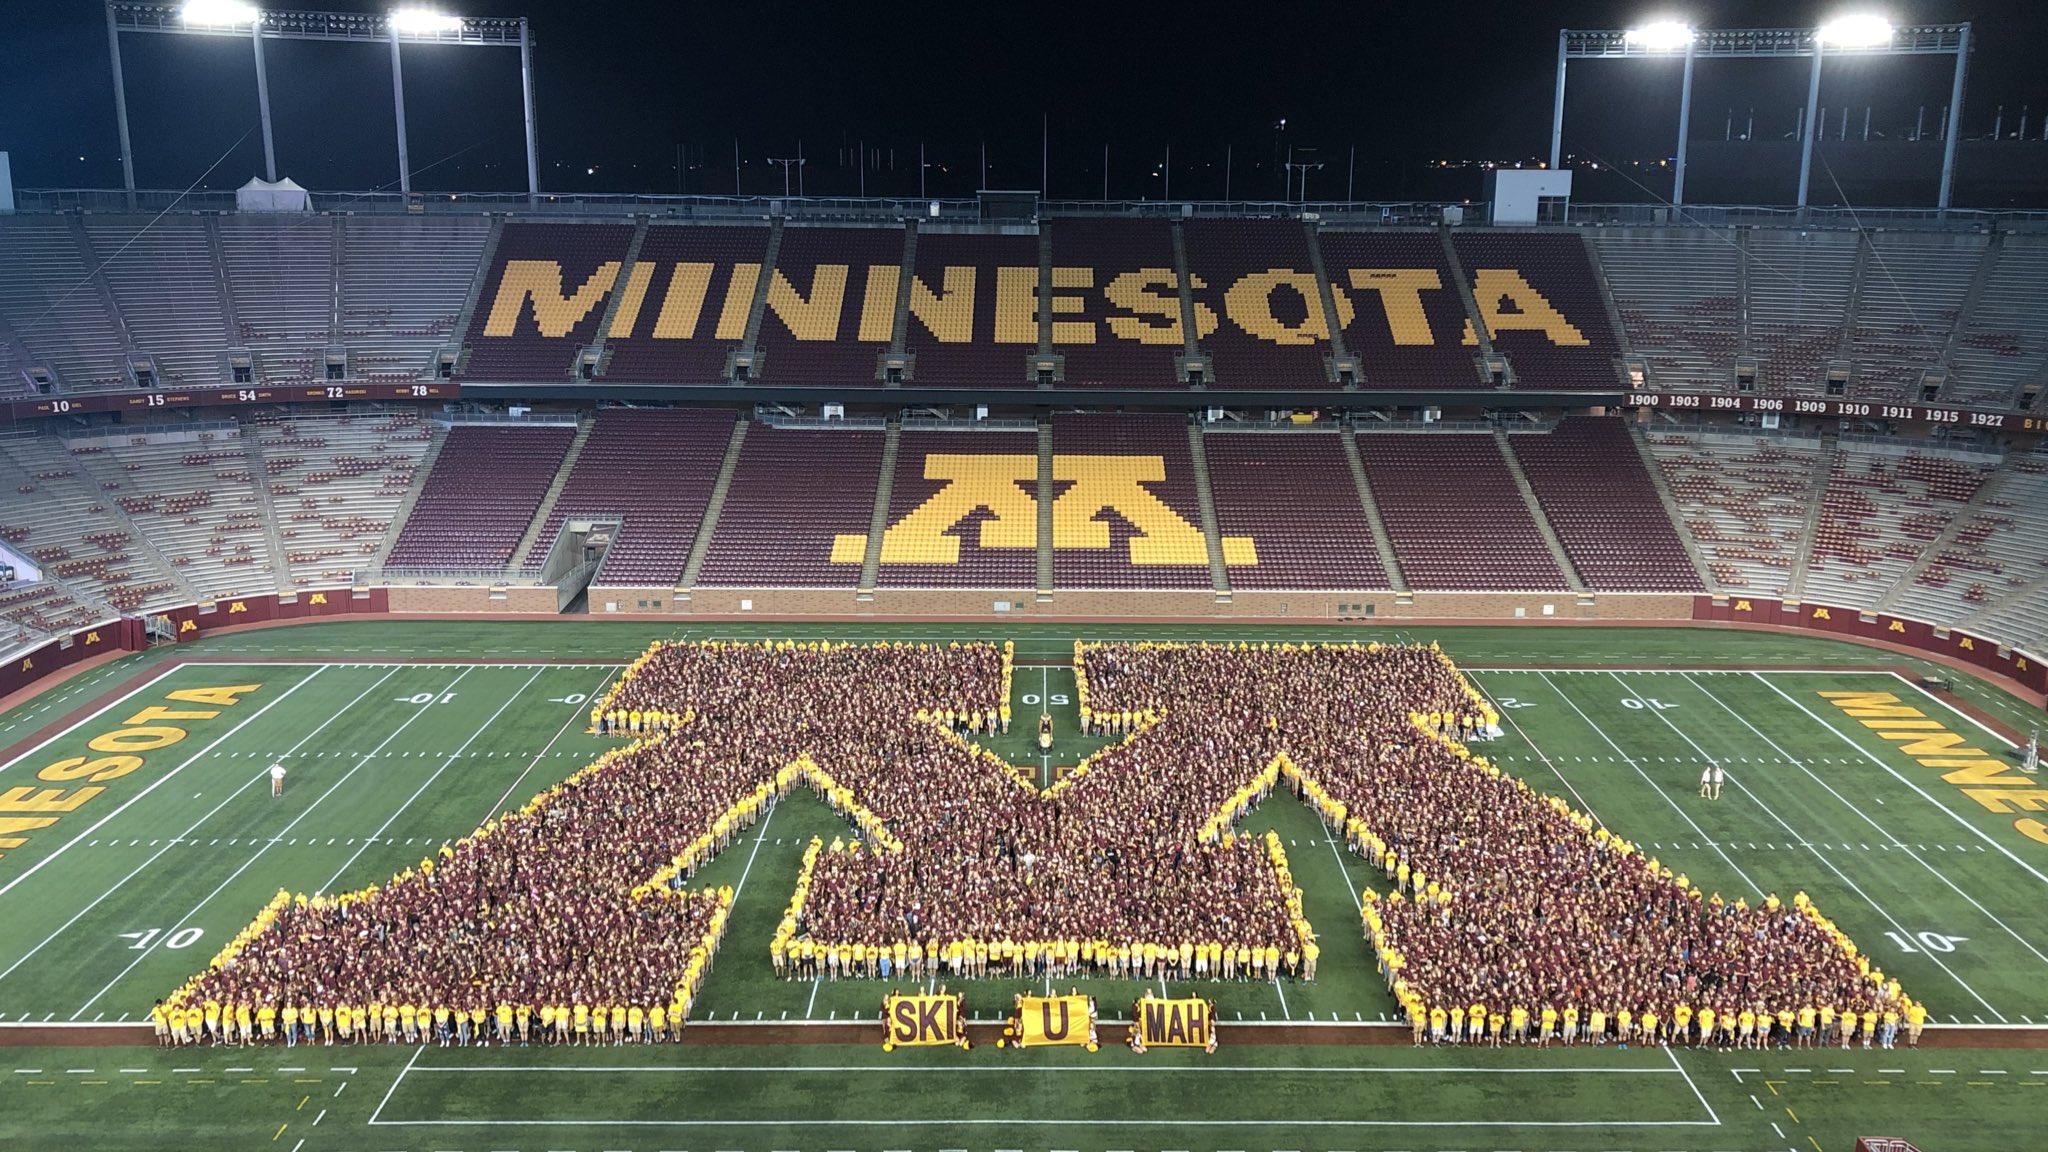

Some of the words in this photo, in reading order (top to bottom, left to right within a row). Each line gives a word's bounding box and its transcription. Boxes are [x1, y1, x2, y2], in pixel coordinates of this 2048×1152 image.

[483, 260, 1590, 346] MINNESOTA
[239, 390, 256, 402] 54
[327, 387, 343, 398] 72
[412, 385, 428, 396] 78
[52, 400, 70, 413] 10
[147, 394, 165, 406] 15
[1629, 394, 1659, 406] 1900
[1670, 395, 1700, 407] 1903
[1710, 396, 1741, 409] 1904
[1753, 398, 1783, 411] 1906
[1795, 401, 1826, 413] 1909
[1838, 403, 1870, 415] 1910
[1882, 406, 1913, 419] 1911
[1925, 409, 1959, 423] 1915
[1970, 413, 2004, 427] 1927
[2024, 418, 2048, 431] BI
[309, 593, 327, 605] M
[229, 601, 248, 614] M
[1734, 600, 1752, 612] M
[1813, 608, 1831, 620] M
[180, 619, 198, 634] M
[1888, 620, 1906, 633] M
[85, 631, 101, 645] M
[1959, 637, 1974, 651] M
[22, 656, 34, 672] M
[2016, 657, 2028, 672] M
[1022, 694, 1070, 705] 50
[127, 927, 204, 950] 10
[1884, 931, 1956, 953] 10
[894, 1000, 954, 1043] SKI
[1042, 1001, 1069, 1041] U
[1145, 1003, 1206, 1044] MAH
